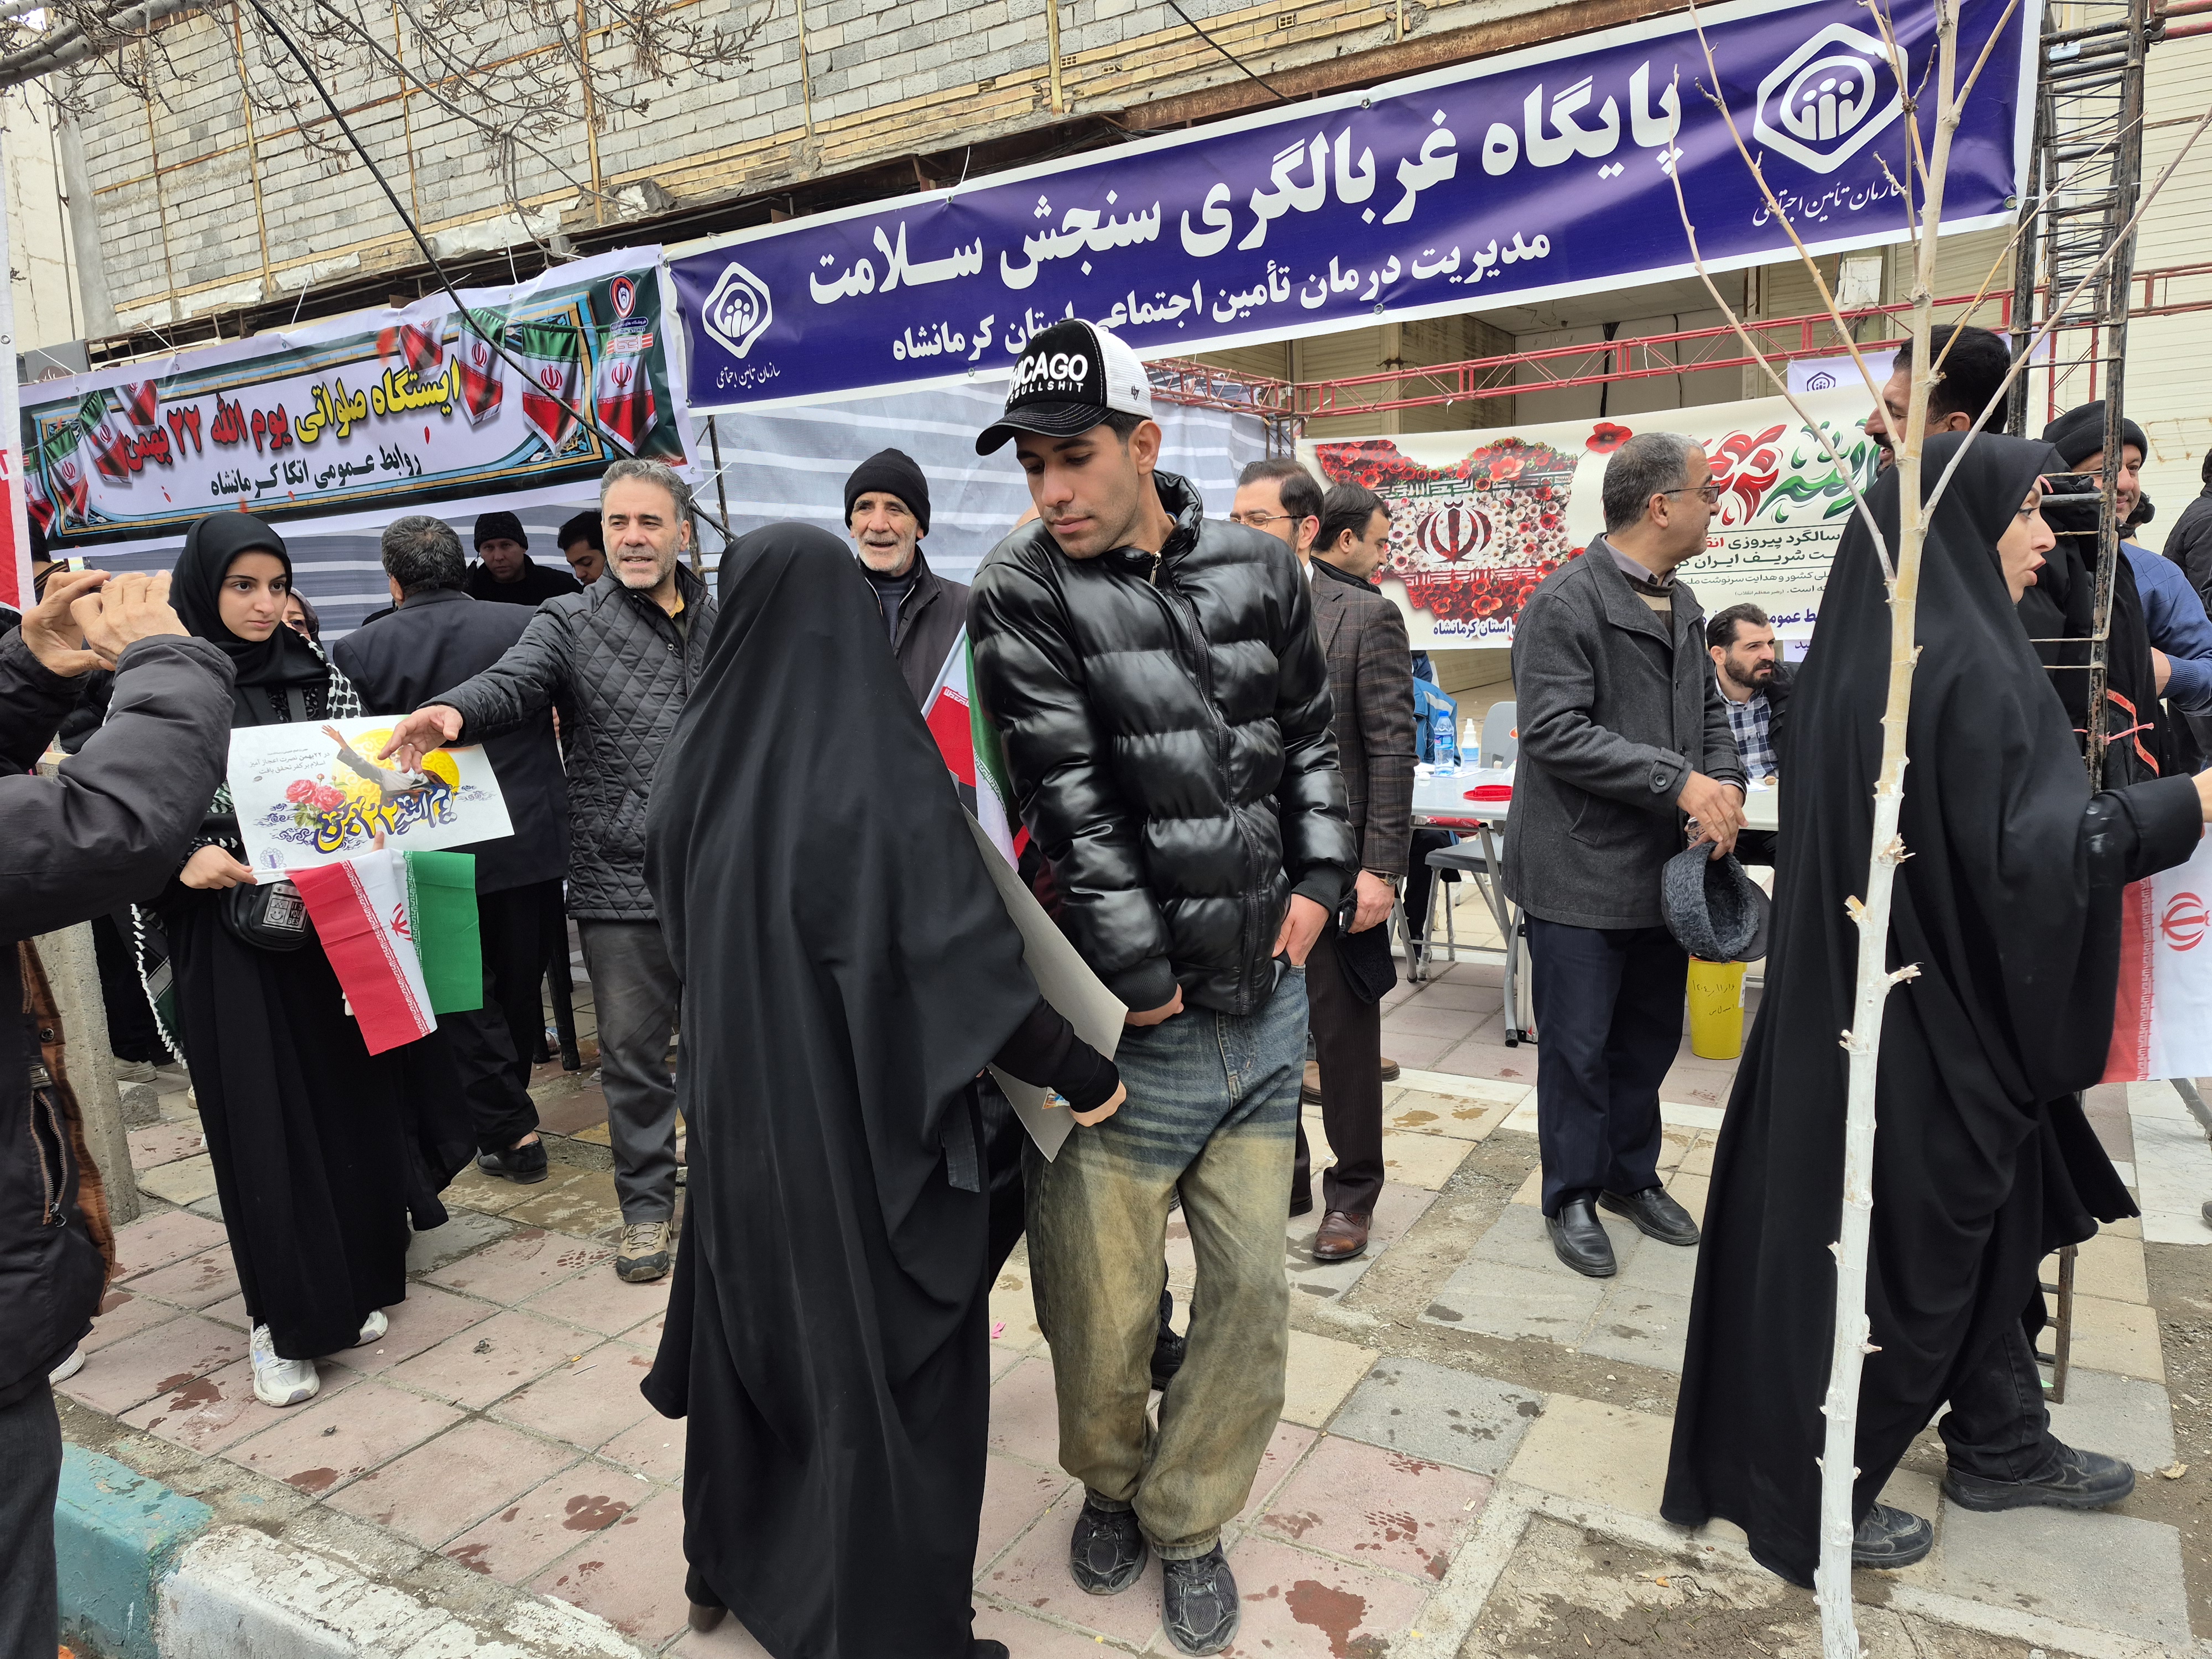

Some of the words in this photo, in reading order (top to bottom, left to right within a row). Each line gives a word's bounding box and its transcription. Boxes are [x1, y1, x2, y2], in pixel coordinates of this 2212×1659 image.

[1482, 59, 1682, 180] پایگاه
[1181, 108, 1458, 257] غربالگری
[809, 221, 983, 304] سلامت
[1000, 190, 1160, 290] سنجش
[1411, 230, 1551, 285] مدیریت
[1213, 258, 1291, 323] تأمین
[1301, 254, 1401, 309] درمان
[892, 313, 994, 361] کرمانشاه
[371, 354, 461, 416] ایستگاه
[716, 366, 738, 389] اجتماعی
[757, 362, 780, 383] سازمان
[167, 404, 202, 456] ۲۲
[211, 392, 247, 445] الله
[251, 403, 293, 453] یوم
[295, 377, 367, 444] صلواتی
[124, 425, 173, 472] بهمن
[283, 457, 309, 486] اتکا
[315, 454, 374, 489] عمومی
[379, 442, 422, 477] روابط
[211, 462, 278, 498] کرمانشاه
[1694, 554, 1739, 568] ایران
[1728, 535, 1783, 551] پیروزی
[1743, 550, 1804, 565] شریف
[1786, 530, 1840, 546] سالگرد
[1785, 571, 1814, 582] کشور
[1433, 620, 1478, 638] کرمانشاه
[1480, 620, 1510, 637] استان
